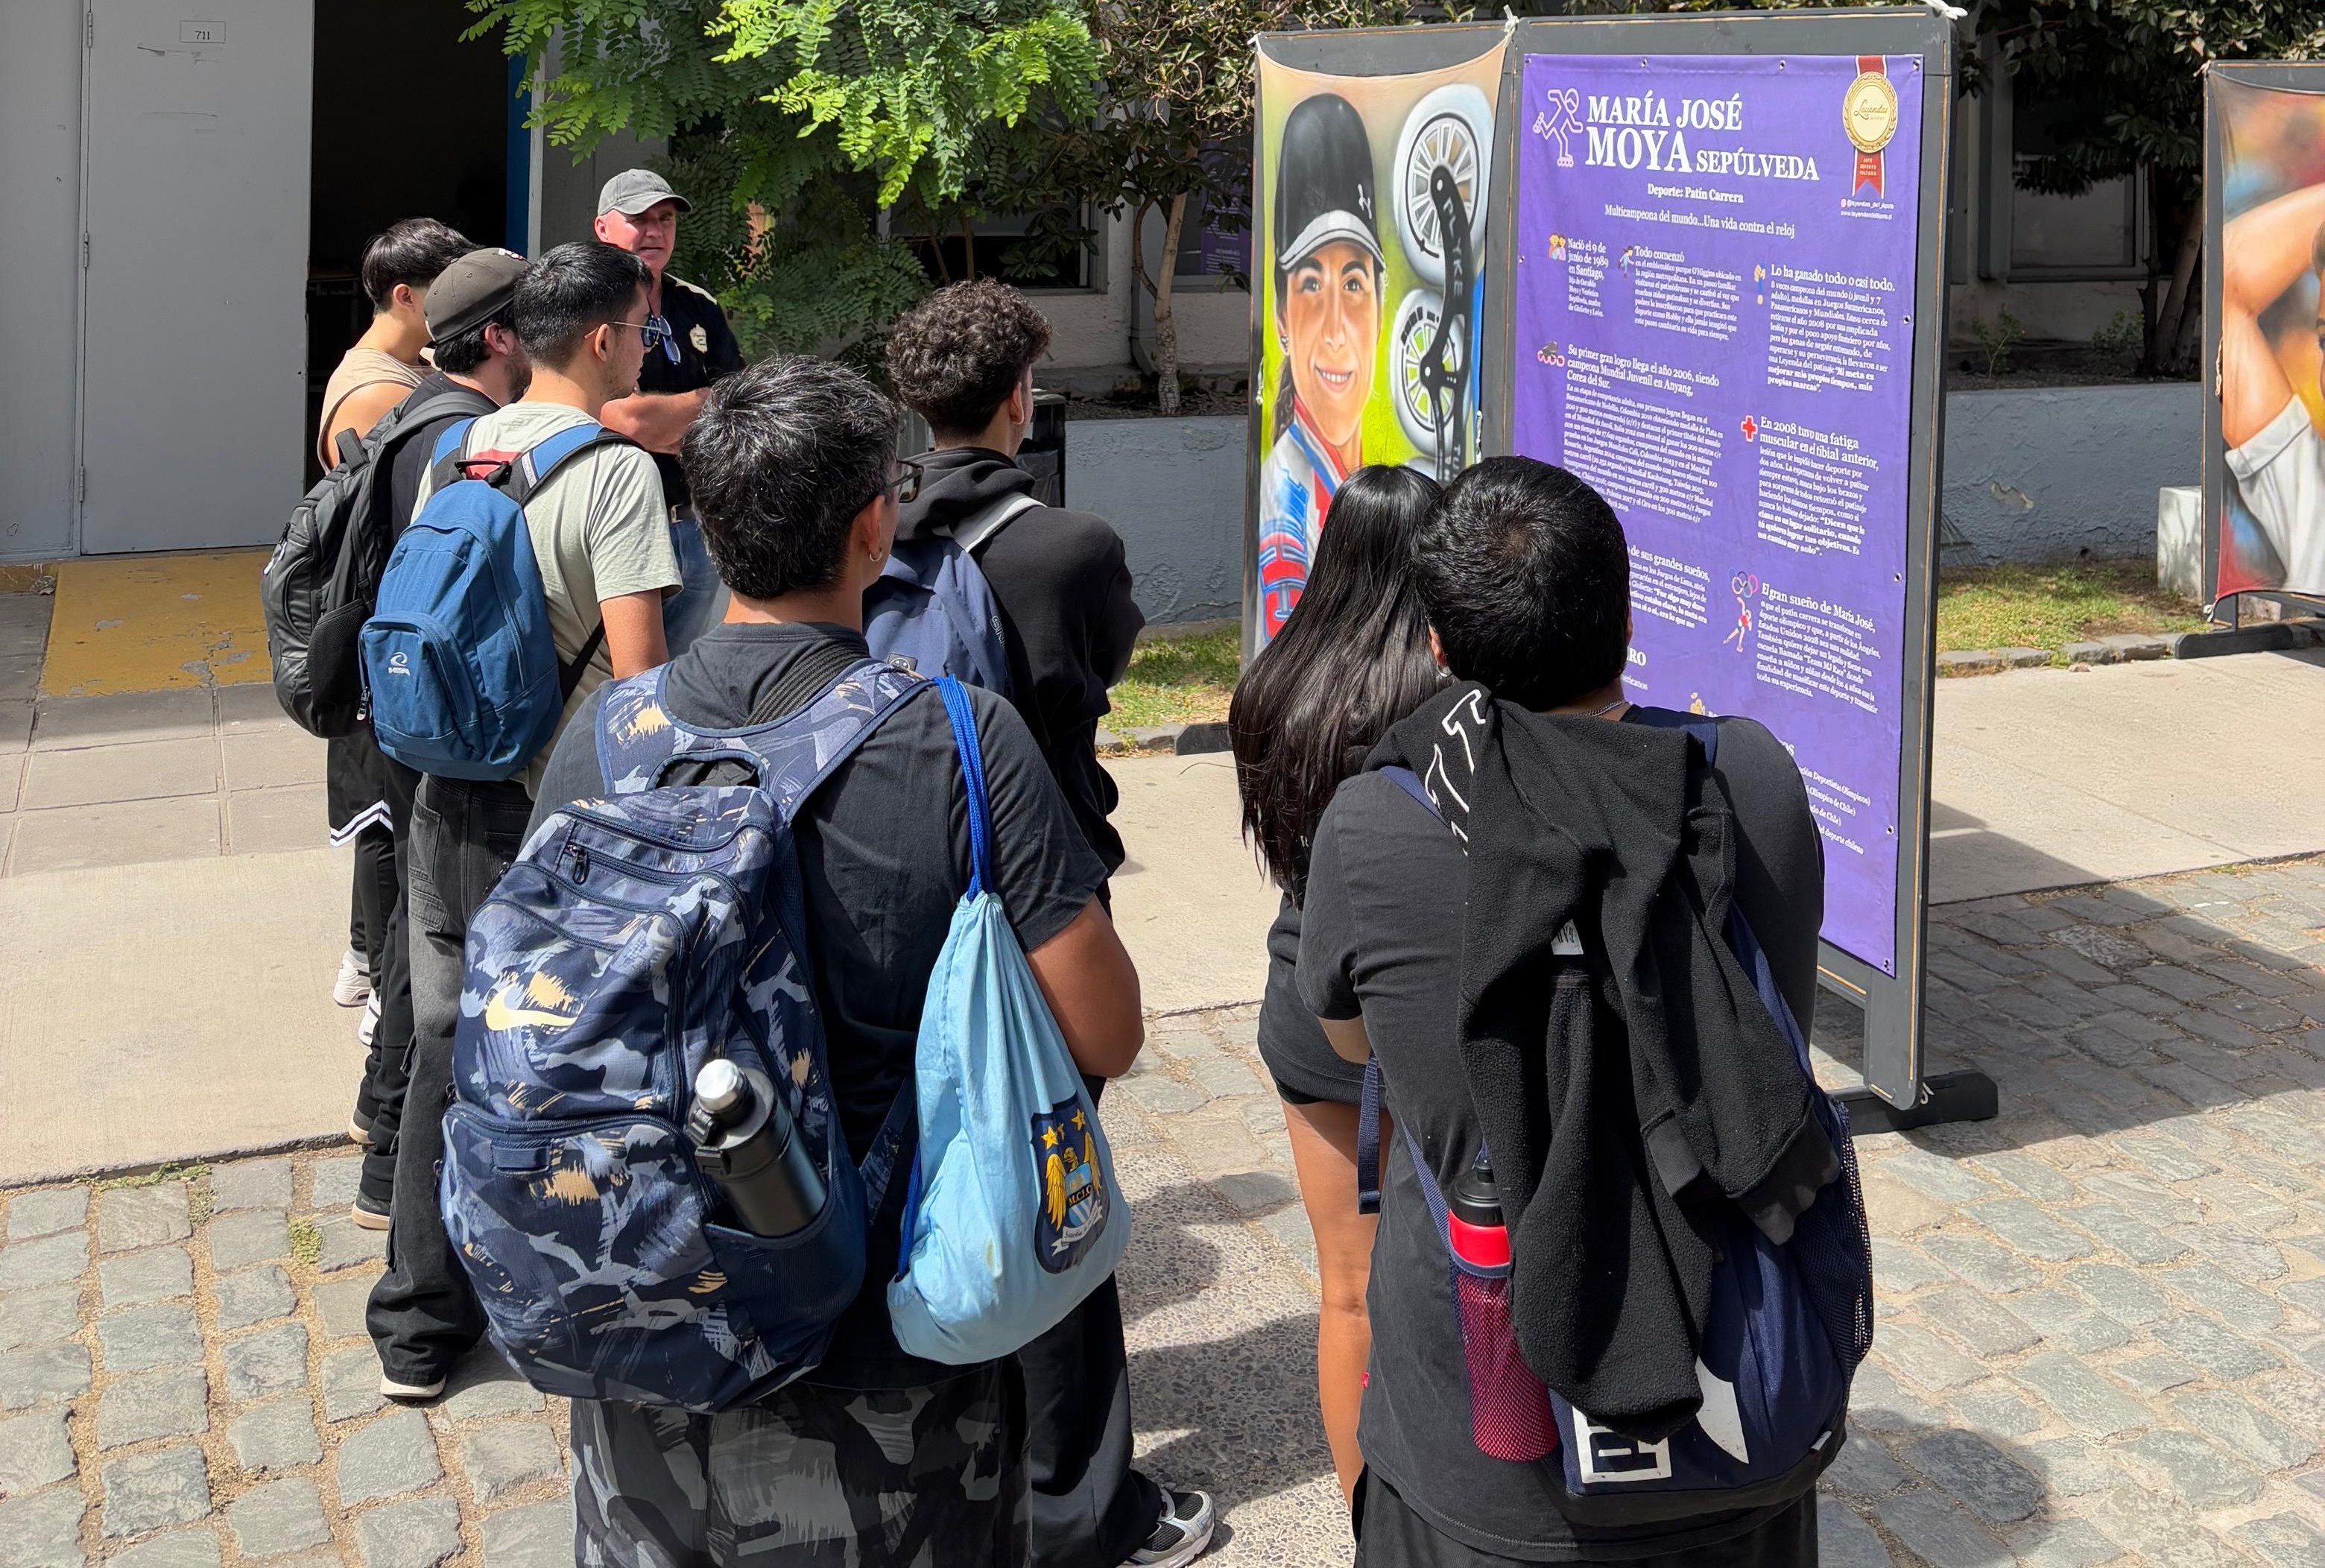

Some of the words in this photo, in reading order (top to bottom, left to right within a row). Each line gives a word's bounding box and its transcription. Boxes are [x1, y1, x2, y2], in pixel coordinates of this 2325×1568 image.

[195, 31, 210, 39] 711
[1587, 90, 1670, 126] MARÍA
[1676, 93, 1742, 130] JOSÉ
[1586, 127, 1692, 173] MOYA
[1696, 147, 1820, 180] SEPÚLVEDA
[1648, 183, 1683, 198] Deporte:
[1685, 187, 1707, 200] Patín
[1709, 189, 1744, 203] Carrera
[1605, 204, 1658, 221] Multicampeona
[1659, 210, 1670, 222] del
[1721, 217, 1738, 230] vida
[1739, 222, 1765, 233] contra
[1767, 222, 1774, 234] el
[1776, 223, 1794, 239] reloj
[1585, 241, 1592, 251] el
[1592, 244, 1597, 253] 9
[1598, 242, 1606, 253] de
[1634, 246, 1652, 258] Todo
[1654, 251, 1684, 262] comenzó
[1584, 253, 1592, 264] de
[1594, 256, 1609, 268] 1989
[1576, 265, 1604, 280] Santiago,
[1771, 264, 1782, 276] Lo
[1783, 265, 1794, 278] ha
[1794, 269, 1823, 282] ganado
[1825, 272, 1847, 285] todo
[1849, 277, 1854, 285] o
[1856, 276, 1868, 288] casi
[1816, 287, 1825, 296] del
[1826, 290, 1848, 299] mundo
[1823, 299, 1844, 310] Juegos
[1806, 330, 1820, 338] poco
[1863, 340, 1876, 348] por
[1863, 349, 1873, 358] de
[1568, 344, 1577, 355] Su
[1578, 347, 1599, 360] primer
[1600, 354, 1613, 364] gran
[1614, 354, 1631, 369] logro
[1633, 358, 1649, 373] llega
[1651, 362, 1657, 373] el
[1658, 364, 1672, 376] año
[1673, 369, 1694, 382] 2006,
[1695, 372, 1719, 386] siendo
[1567, 370, 1587, 383] Corea
[1588, 374, 1597, 386] del
[1598, 377, 1611, 389] Sur.
[1568, 359, 1599, 373] campeona
[1601, 364, 1626, 380] Mundial
[1627, 370, 1652, 386] Juvenil
[1654, 379, 1663, 388] en
[1664, 379, 1693, 396] Anyang,
[1761, 417, 1772, 429] En
[1774, 422, 1797, 434] 2008
[1798, 426, 1815, 439] tuvo
[1815, 432, 1829, 443] una
[1830, 433, 1859, 450] fatiga
[1760, 434, 1799, 449] muscular
[1800, 443, 1809, 452] en
[1809, 443, 1815, 455] el
[1817, 446, 1839, 461] tibial
[1841, 453, 1879, 471] anterior,
[1630, 545, 1640, 557] de
[1641, 551, 1653, 561] sus
[1654, 555, 1683, 571] grandes
[1684, 565, 1710, 583] sueños,
[1762, 583, 1770, 599] El
[1769, 589, 1788, 602] gran
[1789, 595, 1818, 610] sueño
[1820, 601, 1832, 614] de
[1833, 604, 1854, 624] María
[1855, 614, 1876, 633] José,
